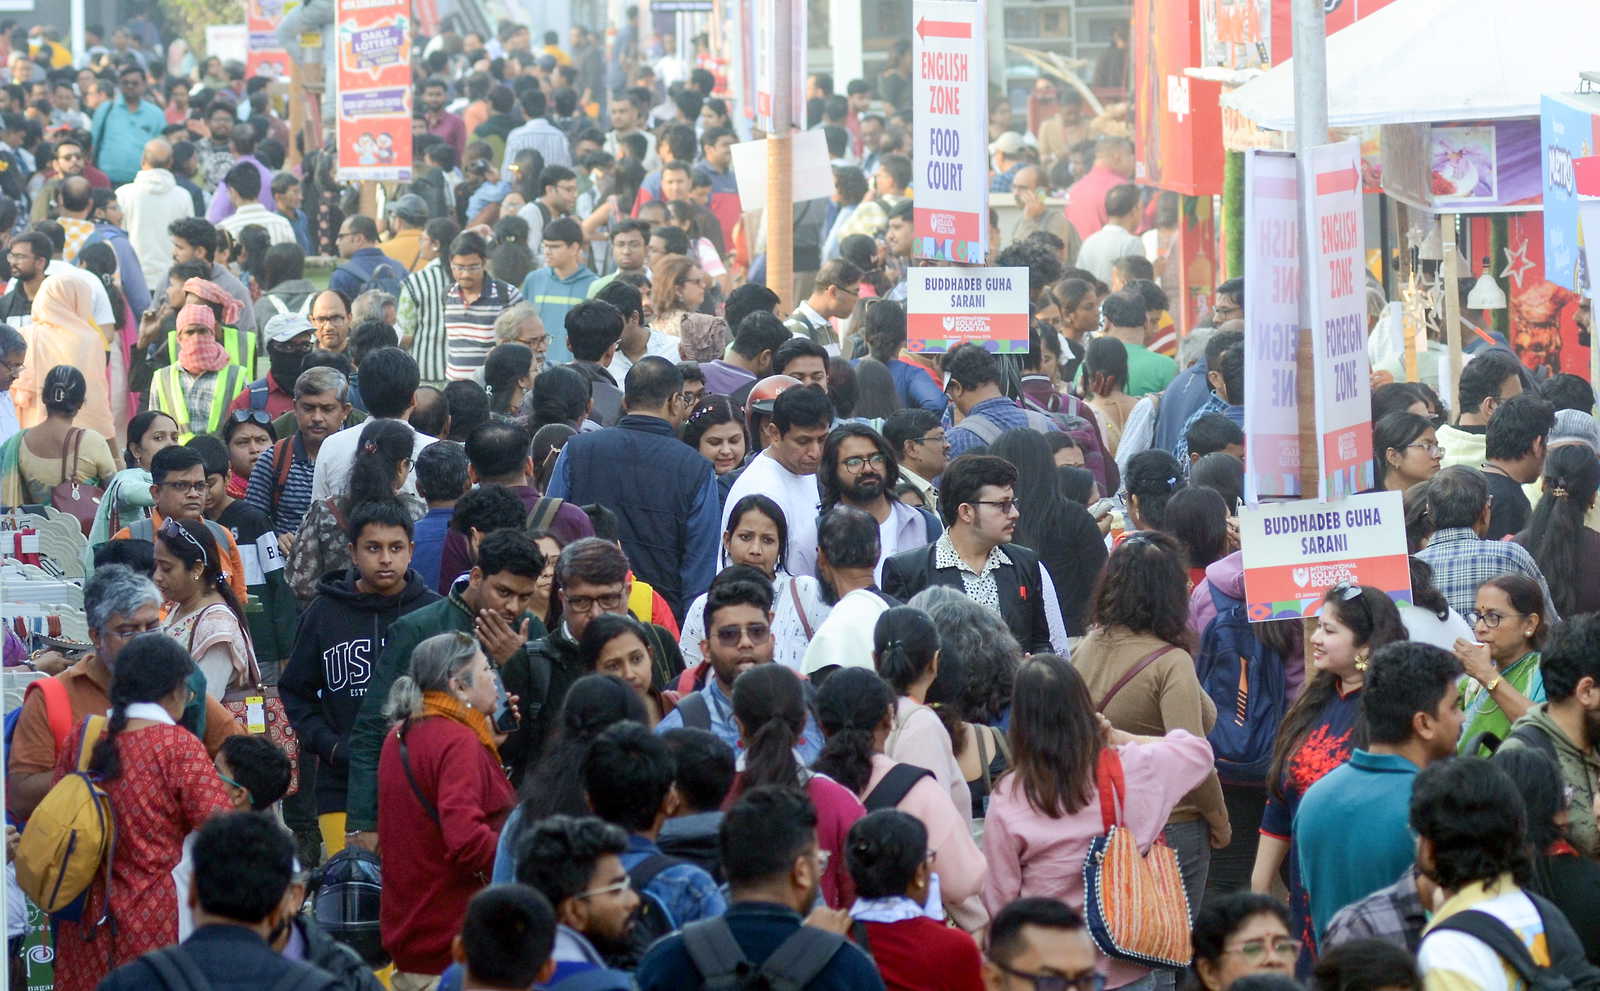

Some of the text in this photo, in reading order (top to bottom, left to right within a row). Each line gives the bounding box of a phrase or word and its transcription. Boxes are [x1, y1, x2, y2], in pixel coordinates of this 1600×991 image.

[921, 51, 968, 82] ENGLISH
[928, 85, 960, 115] ZONE
[930, 127, 959, 158] FOOD
[927, 160, 963, 191] COURT
[1321, 209, 1358, 255] ENGLISH
[925, 278, 1012, 291] BUDDHADEB GUHA
[1330, 256, 1354, 299] ZONE
[951, 294, 985, 308] SARANI
[1325, 313, 1362, 358] FOREIGN
[1334, 360, 1358, 402] ZONE
[1264, 508, 1381, 536] BUDDHADEB GUHA
[1302, 534, 1348, 555] SARANI
[1311, 570, 1351, 580] KOLKATA
[1311, 578, 1337, 588] BOOK
[324, 638, 384, 692] US
[350, 689, 368, 697] EST
